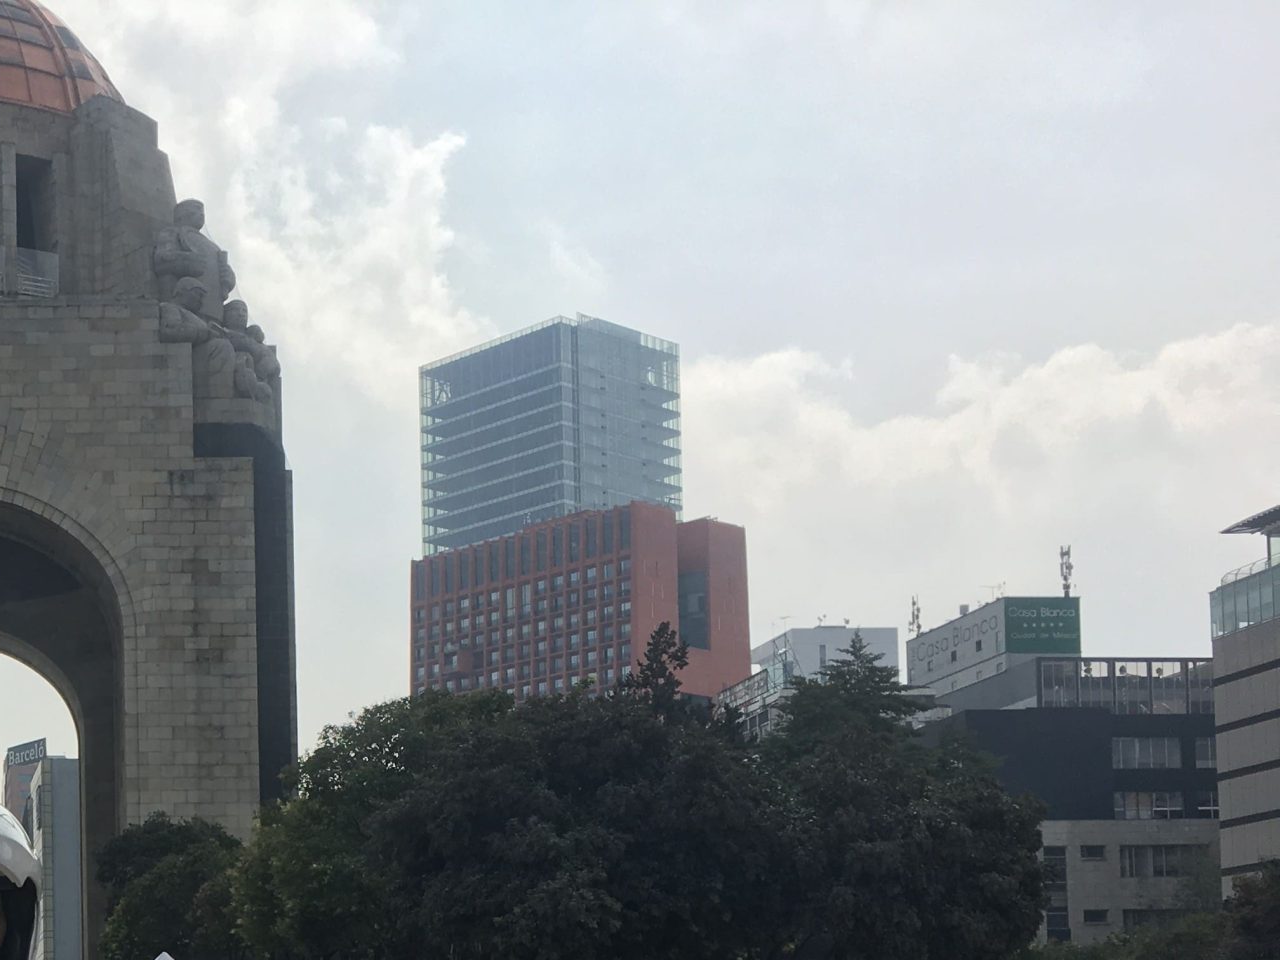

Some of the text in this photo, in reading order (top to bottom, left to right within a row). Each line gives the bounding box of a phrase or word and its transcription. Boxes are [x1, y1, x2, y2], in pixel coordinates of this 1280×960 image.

[1008, 607, 1075, 617] Casa Blanca
[917, 637, 948, 661] Casa
[952, 615, 999, 648] Blanca
[8, 741, 44, 765] Barceló
